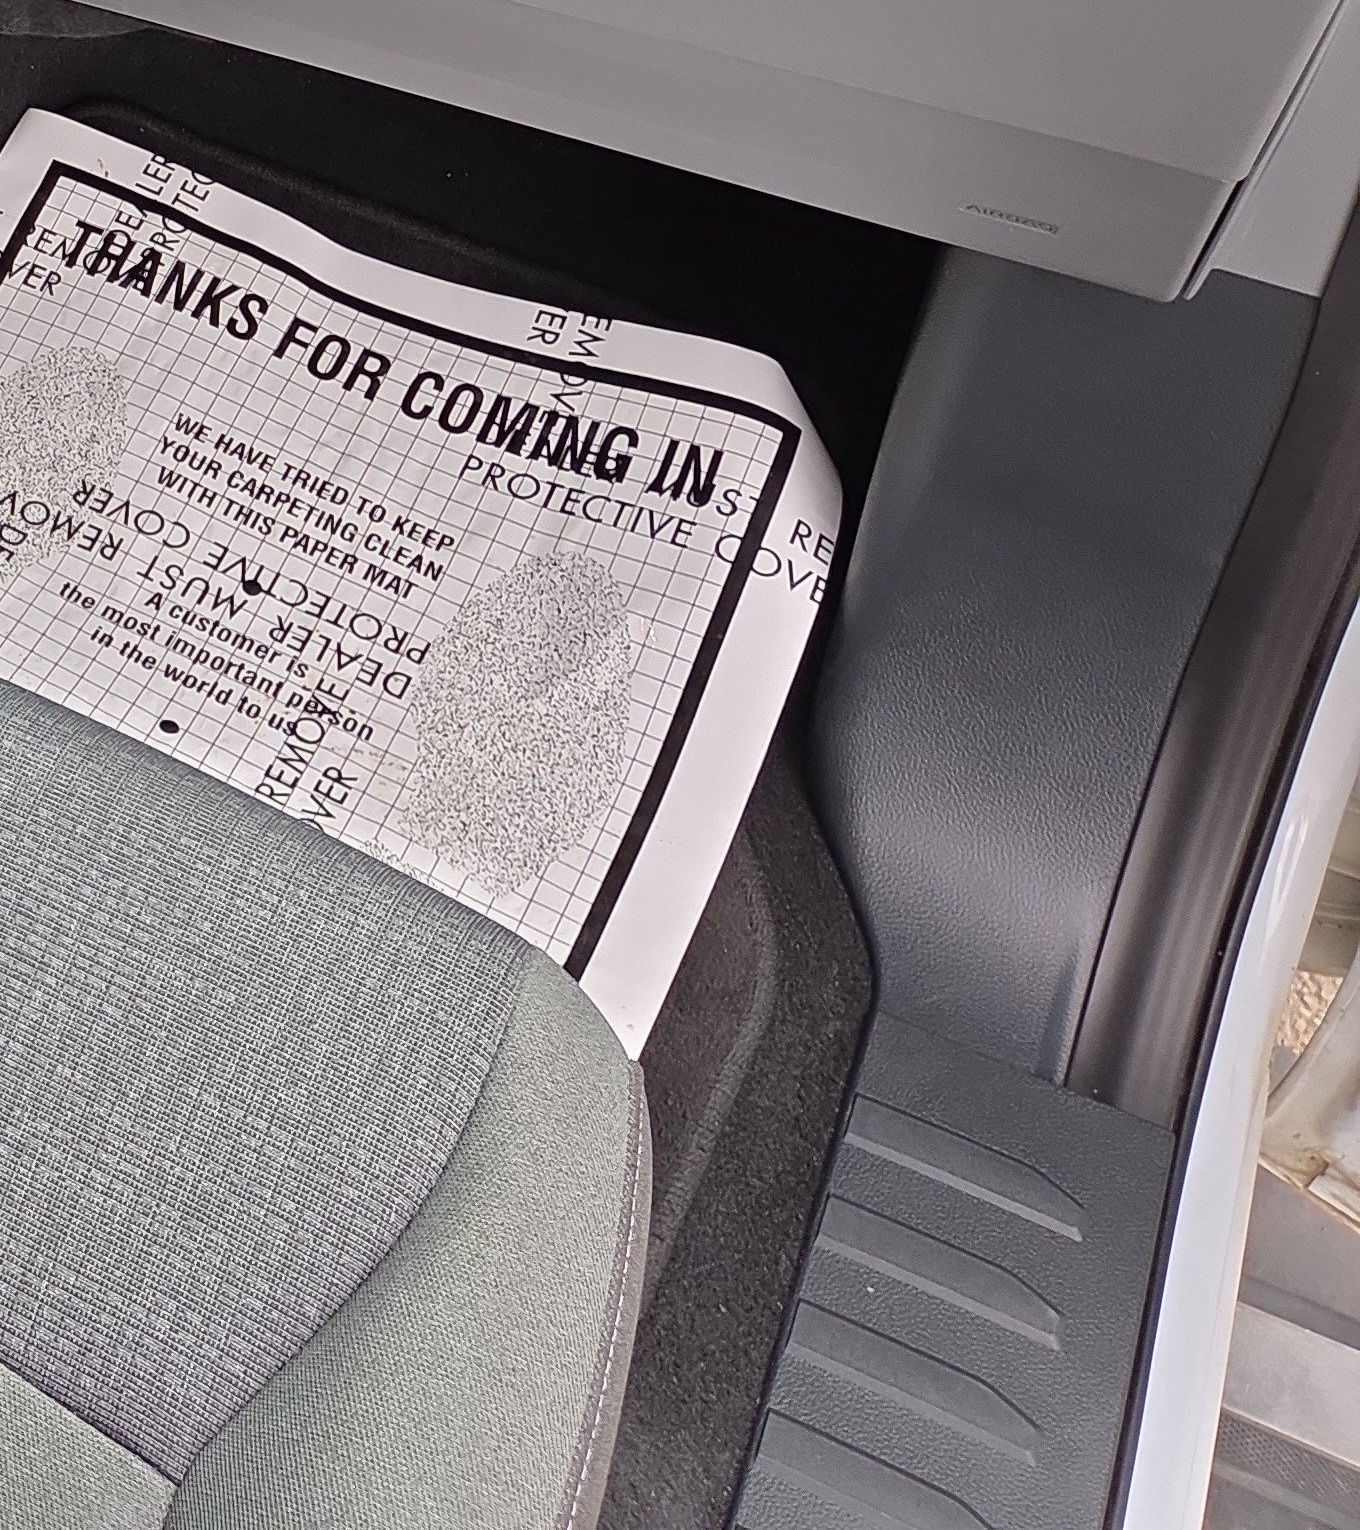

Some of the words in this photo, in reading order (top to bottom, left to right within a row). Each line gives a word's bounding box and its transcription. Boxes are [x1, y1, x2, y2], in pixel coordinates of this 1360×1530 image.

[67, 219, 269, 341] THANKS
[272, 316, 392, 402] FOR
[400, 370, 640, 484] COMING
[652, 438, 725, 507] IN
[72, 478, 191, 550] COVER
[156, 466, 217, 508] WITH
[221, 496, 276, 536] THIS
[279, 524, 359, 575] PAPER
[362, 563, 419, 600] MAT
[160, 435, 222, 480] YOUR
[227, 470, 359, 543] CARPETING
[364, 532, 444, 582] CLEAN
[174, 413, 212, 443] WE
[214, 433, 276, 472] HAVE
[280, 462, 349, 506] TRIED
[356, 495, 387, 523] TO
[391, 514, 455, 553] KEEP
[458, 454, 698, 550] PROTECTIVE
[136, 554, 248, 620] MUST
[144, 592, 164, 612] A
[169, 602, 283, 666] customer
[286, 656, 309, 679] is
[202, 541, 432, 666] PROTECTIVE
[59, 580, 96, 610] the
[100, 604, 161, 642] most
[164, 626, 285, 700] important
[284, 690, 375, 742] person
[90, 625, 114, 648] in
[119, 638, 157, 671] the
[164, 661, 232, 707] world
[238, 694, 262, 721] to
[267, 714, 296, 737] us
[269, 614, 414, 700] DEALER
